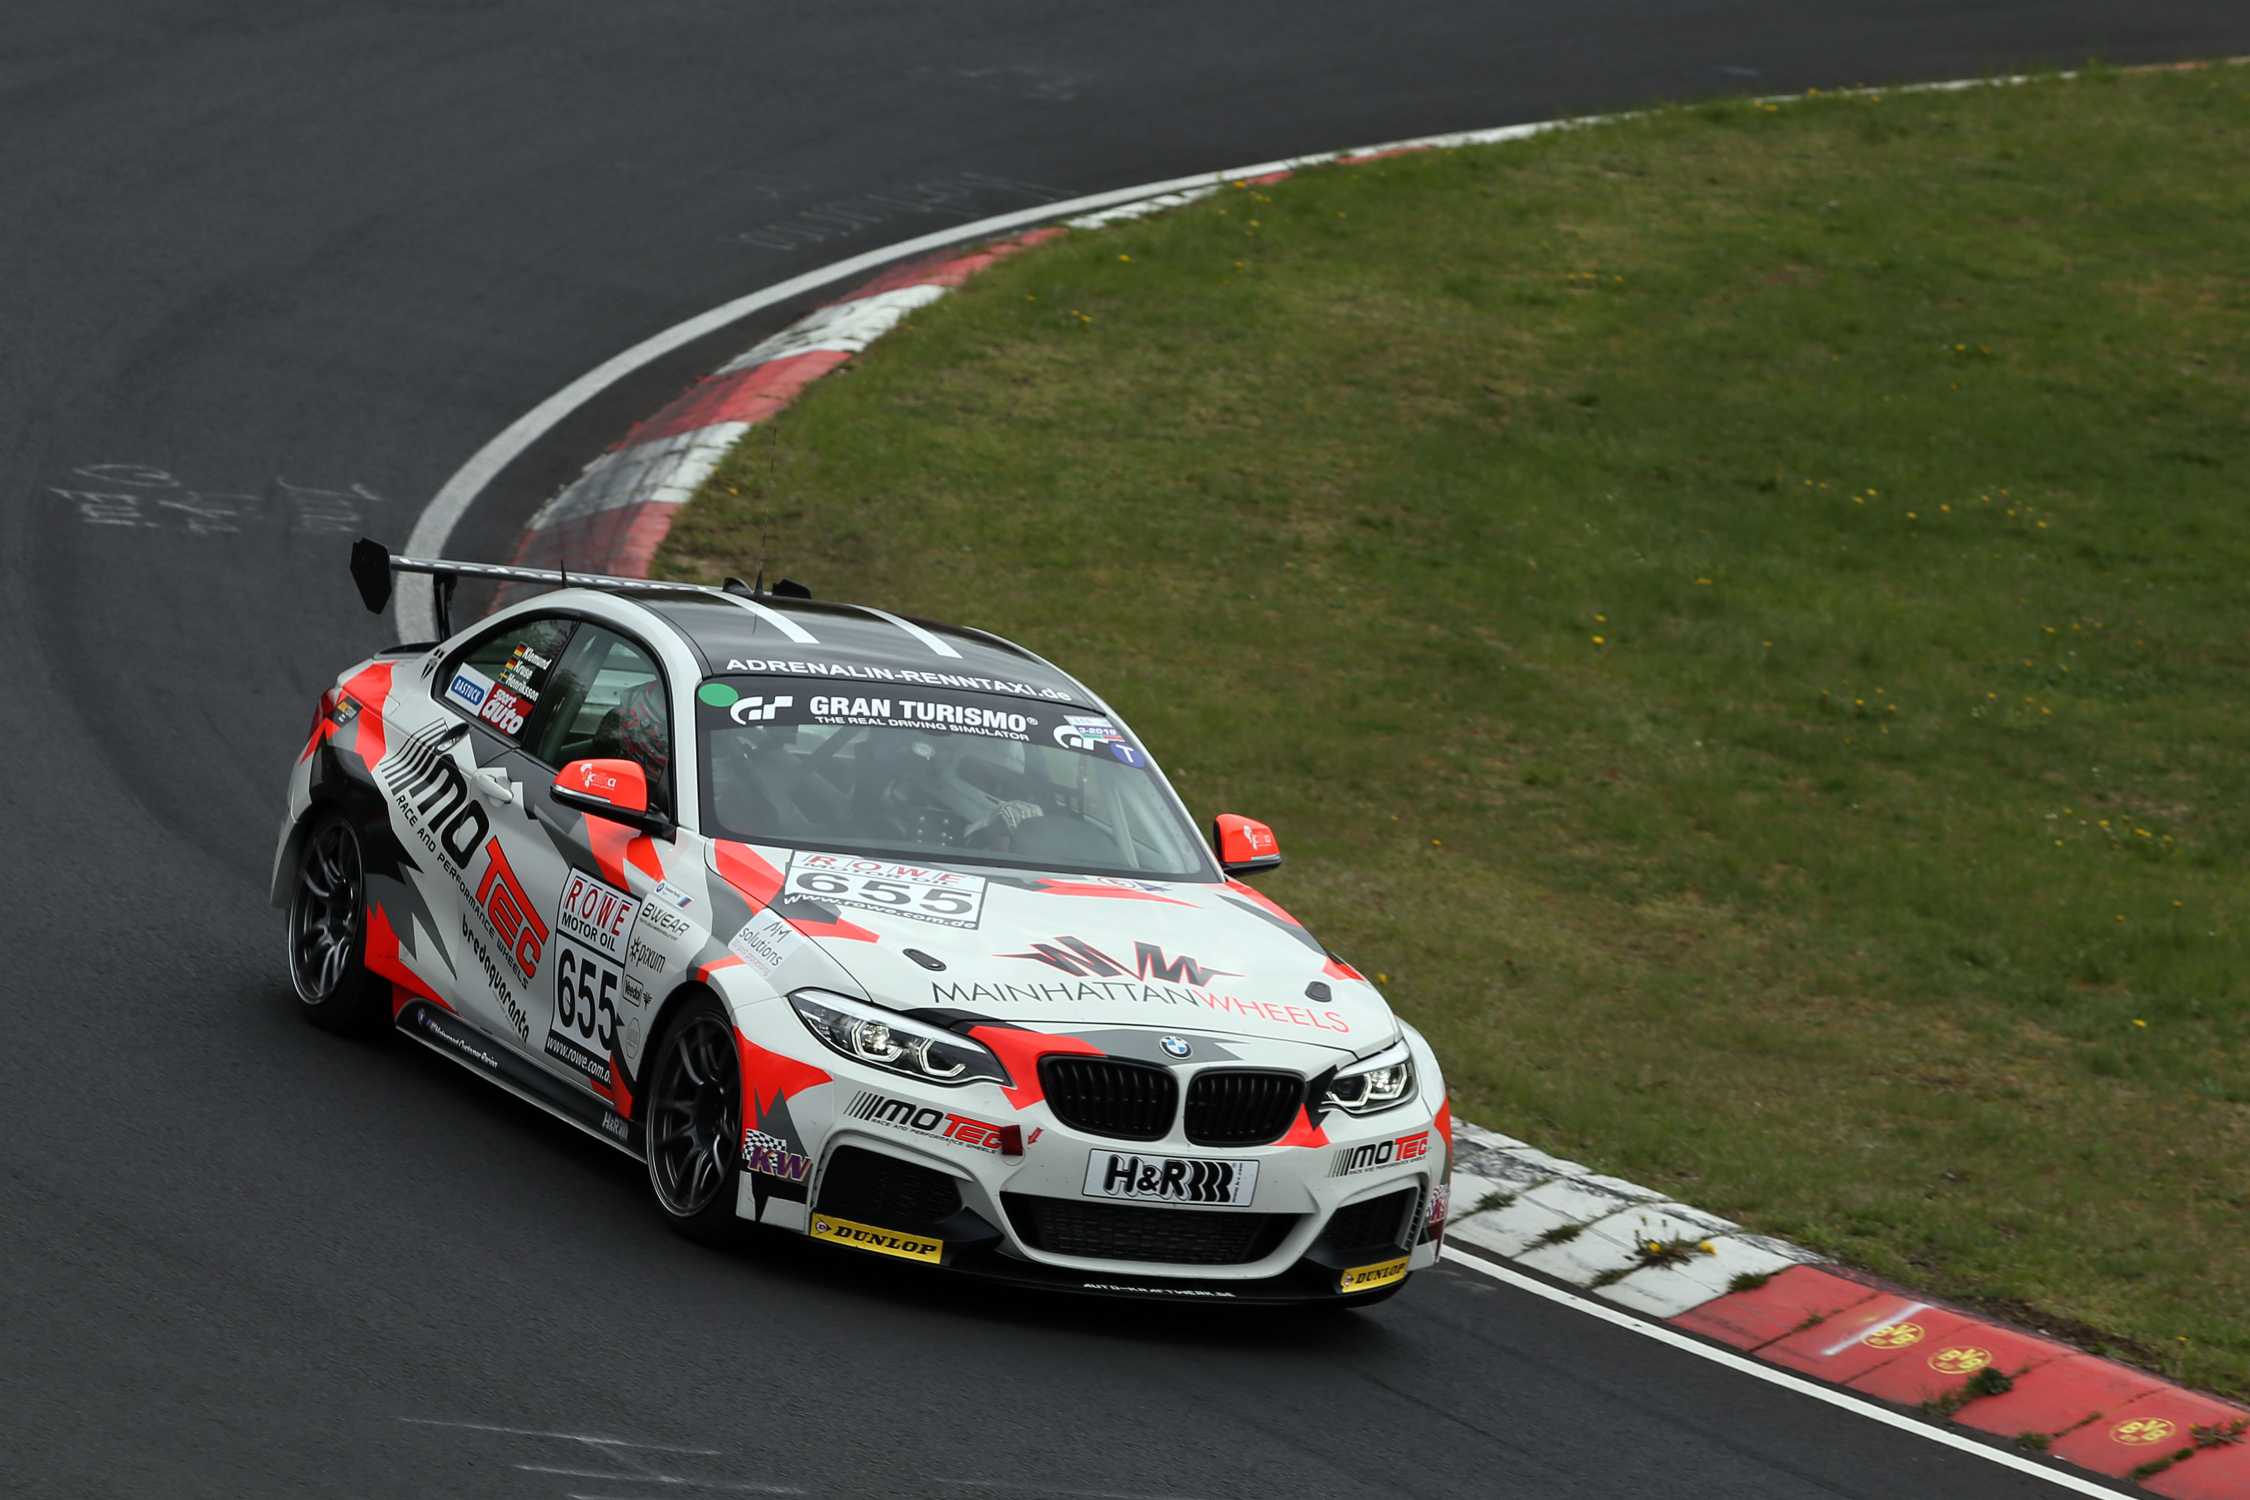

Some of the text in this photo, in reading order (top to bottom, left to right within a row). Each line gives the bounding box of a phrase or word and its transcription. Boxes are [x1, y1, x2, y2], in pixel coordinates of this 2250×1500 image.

[454, 679, 482, 704] BASTUCK
[726, 658, 1072, 701] ADRENALIN-RENNTAXI.de
[482, 698, 524, 735] auto
[809, 696, 891, 718] GRAN
[815, 716, 1030, 742] THE REAL DRIVING SIMULATOR
[1115, 743, 1135, 763] T
[806, 854, 963, 882] ROWE
[395, 794, 419, 827] RACE
[417, 828, 437, 853] AND
[437, 852, 496, 938] PERFORMANCE
[496, 938, 529, 990] WHEELS
[564, 878, 631, 937] ROWE
[796, 871, 973, 916] 655
[641, 902, 690, 936] BWEAR
[784, 893, 976, 929] www.rowe.com.de
[561, 912, 616, 952] MOTOR OIL
[739, 926, 783, 967] solutions
[637, 945, 666, 975] pixum
[557, 948, 617, 1051] 655
[747, 1144, 814, 1182] KW
[1103, 1153, 1195, 1201] H&R
[833, 1225, 937, 1256] DUNLOP
[1355, 1262, 1406, 1284] DUNLOP
